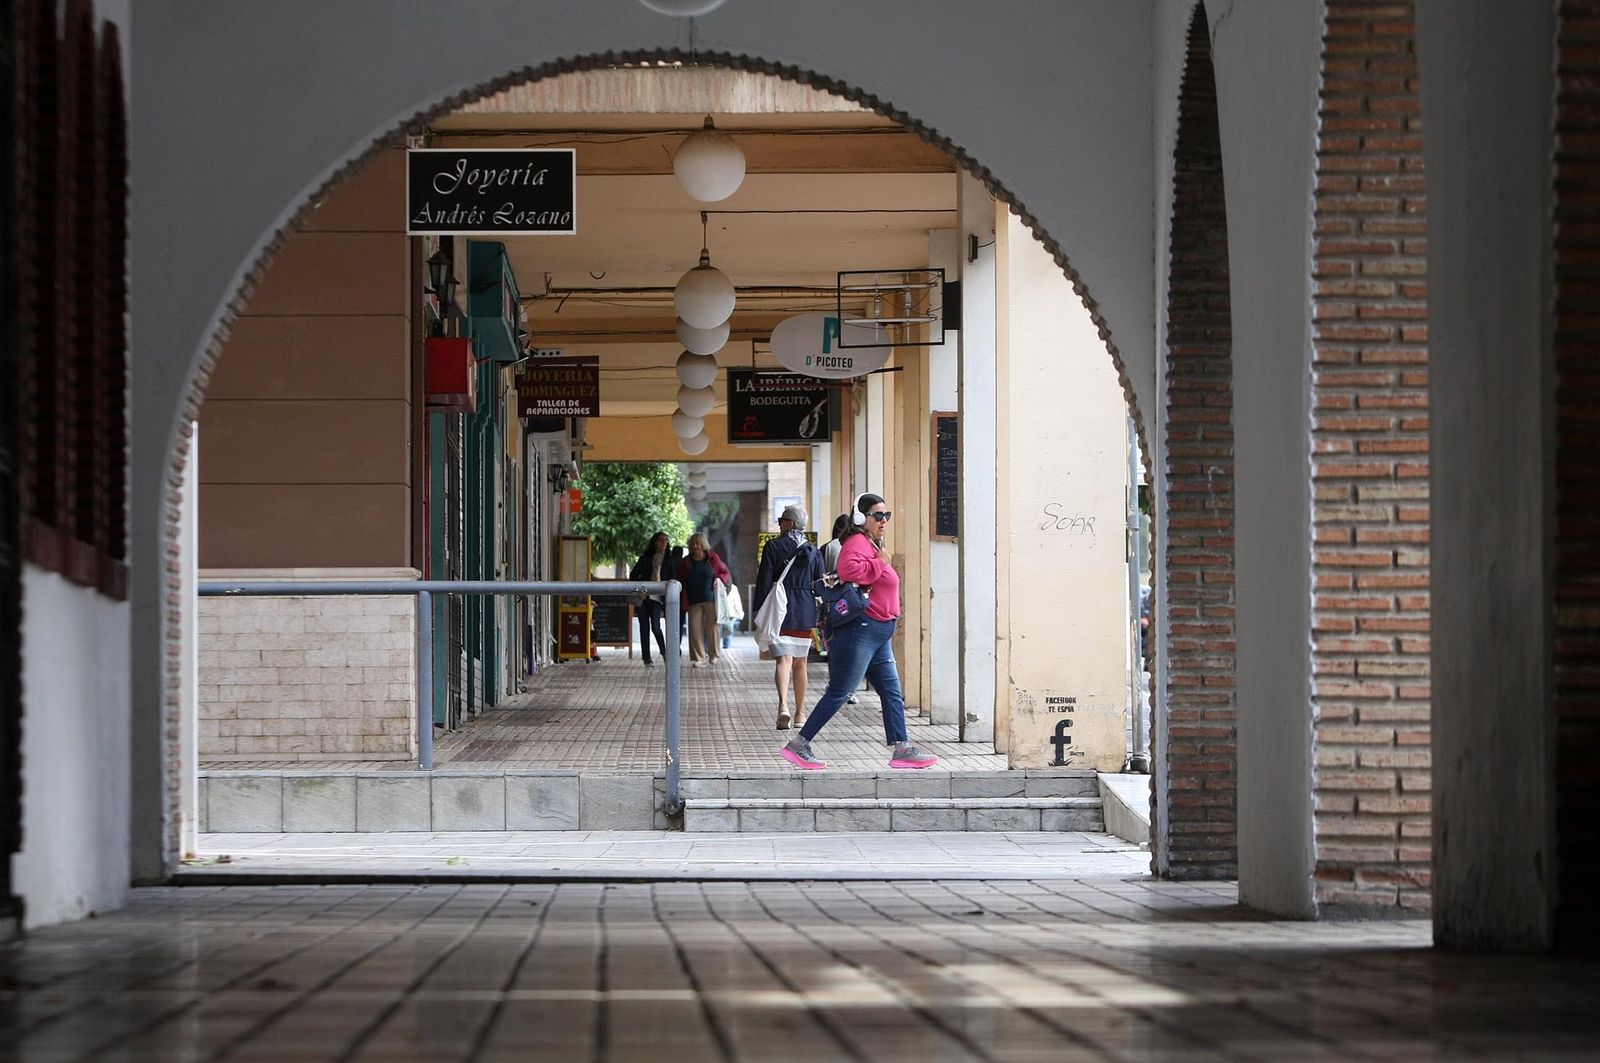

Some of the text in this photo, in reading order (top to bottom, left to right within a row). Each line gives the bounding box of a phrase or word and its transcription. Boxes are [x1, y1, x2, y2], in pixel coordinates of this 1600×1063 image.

[433, 158, 549, 195] Joyería
[411, 201, 571, 225] Andrés Lozano
[816, 356, 853, 368] PICOTEO
[735, 379, 756, 392] LA
[536, 399, 580, 407] TALLER DE
[750, 396, 811, 406] BODEGUITA
[526, 407, 591, 415] REPARACIONES
[1045, 696, 1077, 704] FACEBOOK
